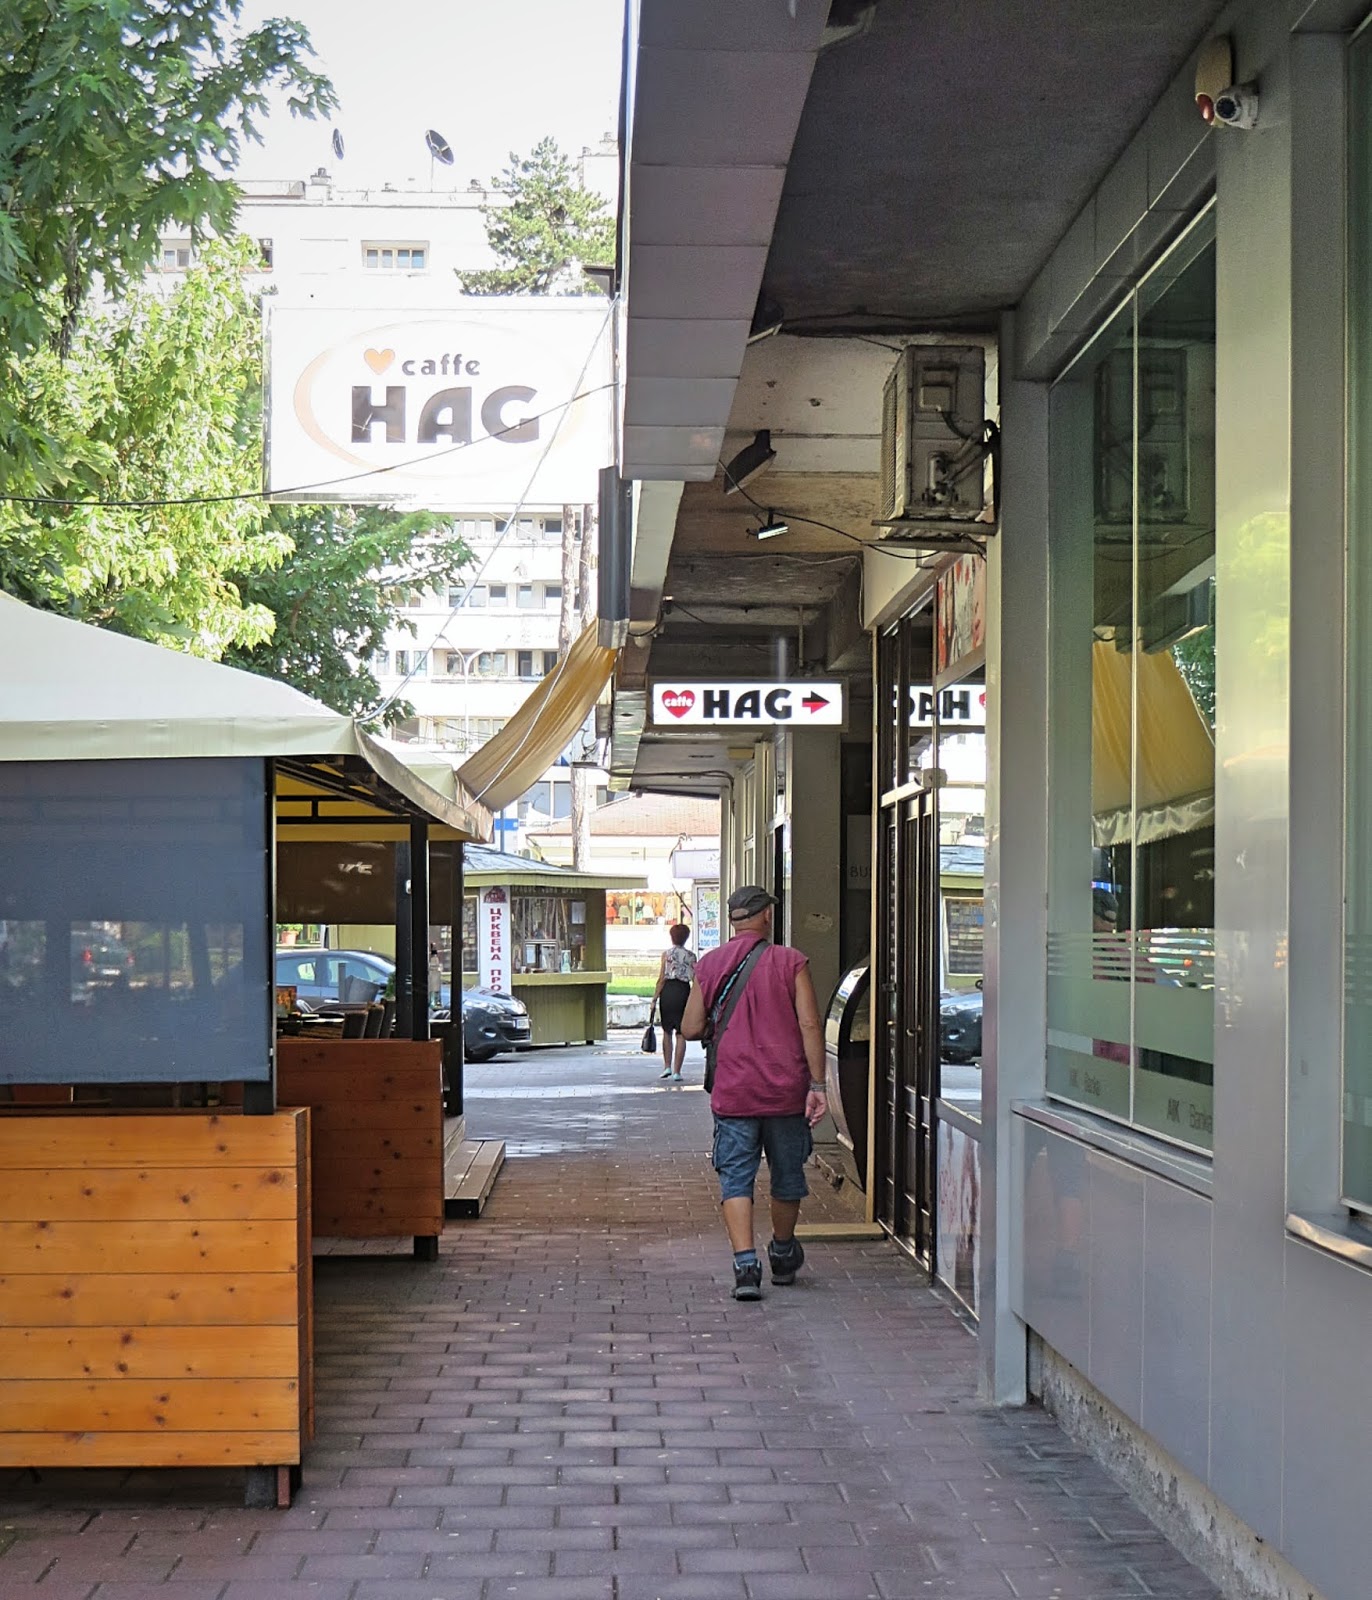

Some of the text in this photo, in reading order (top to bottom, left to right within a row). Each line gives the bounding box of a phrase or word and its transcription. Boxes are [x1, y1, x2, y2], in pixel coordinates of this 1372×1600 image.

[401, 353, 481, 377] caffe
[351, 384, 540, 444] HAG
[664, 688, 793, 720] caffe HAG
[490, 907, 502, 961] ЦРКВЕНА
